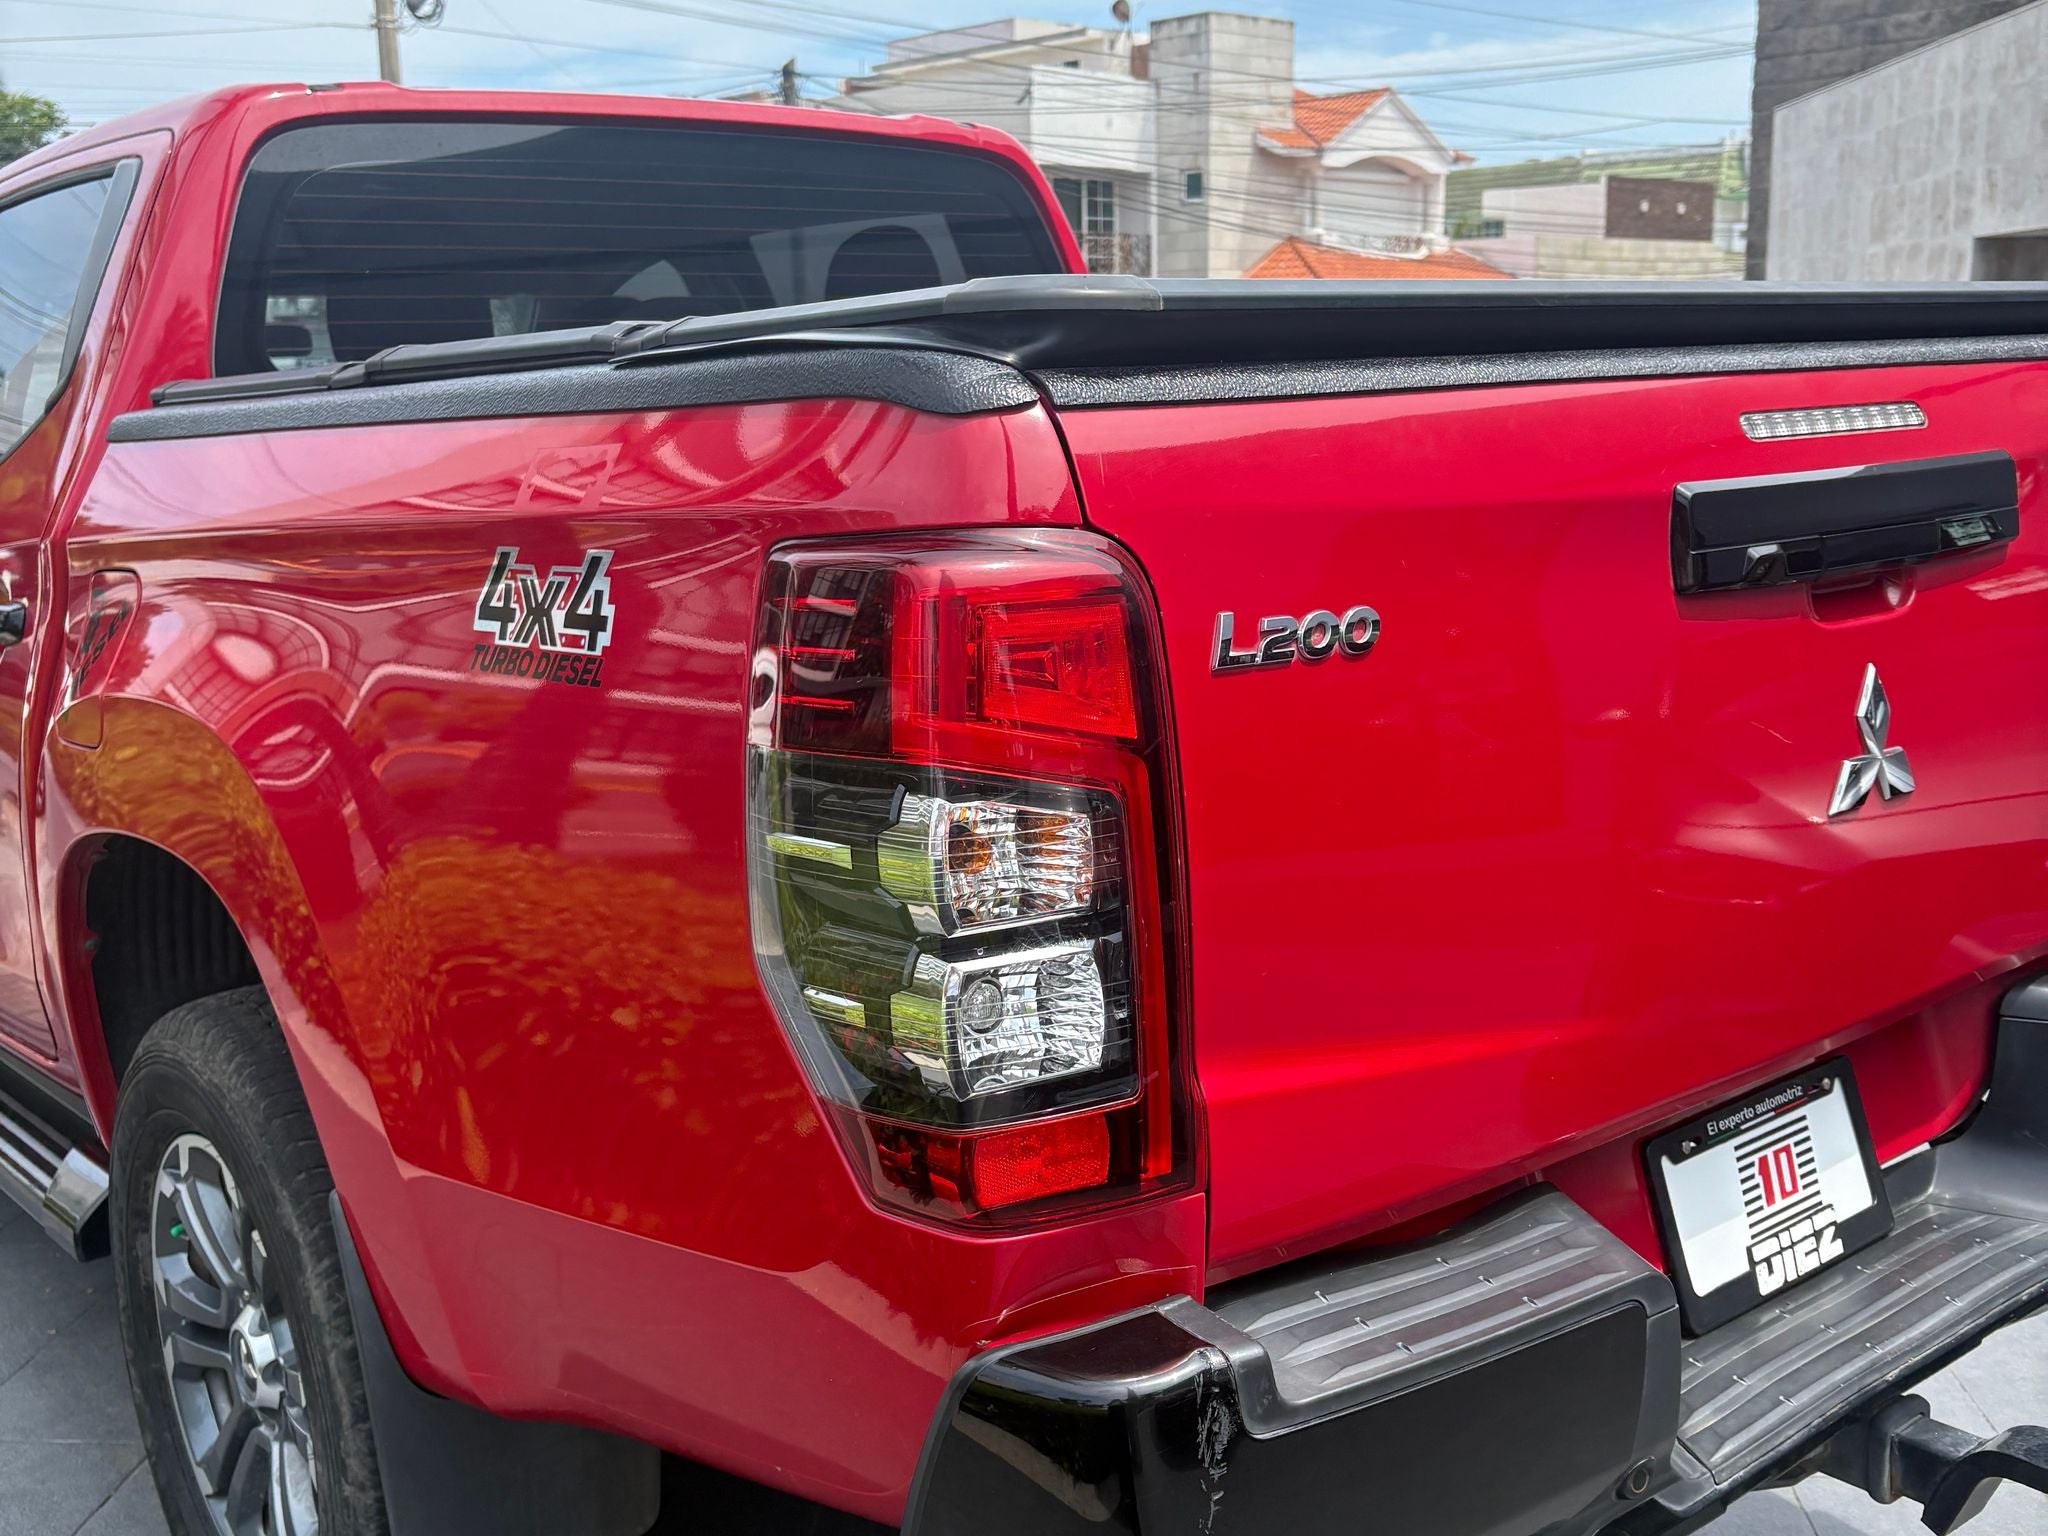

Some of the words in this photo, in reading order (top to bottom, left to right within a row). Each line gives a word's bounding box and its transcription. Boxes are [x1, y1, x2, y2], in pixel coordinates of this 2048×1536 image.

[470, 645, 535, 677] TURBO
[532, 653, 604, 688] DIESEL
[1211, 606, 1381, 673] L200
[1706, 1120, 1718, 1136] El
[1719, 1107, 1755, 1130] experto
[1755, 1085, 1804, 1115] automotriz
[1757, 1143, 1800, 1208] 10
